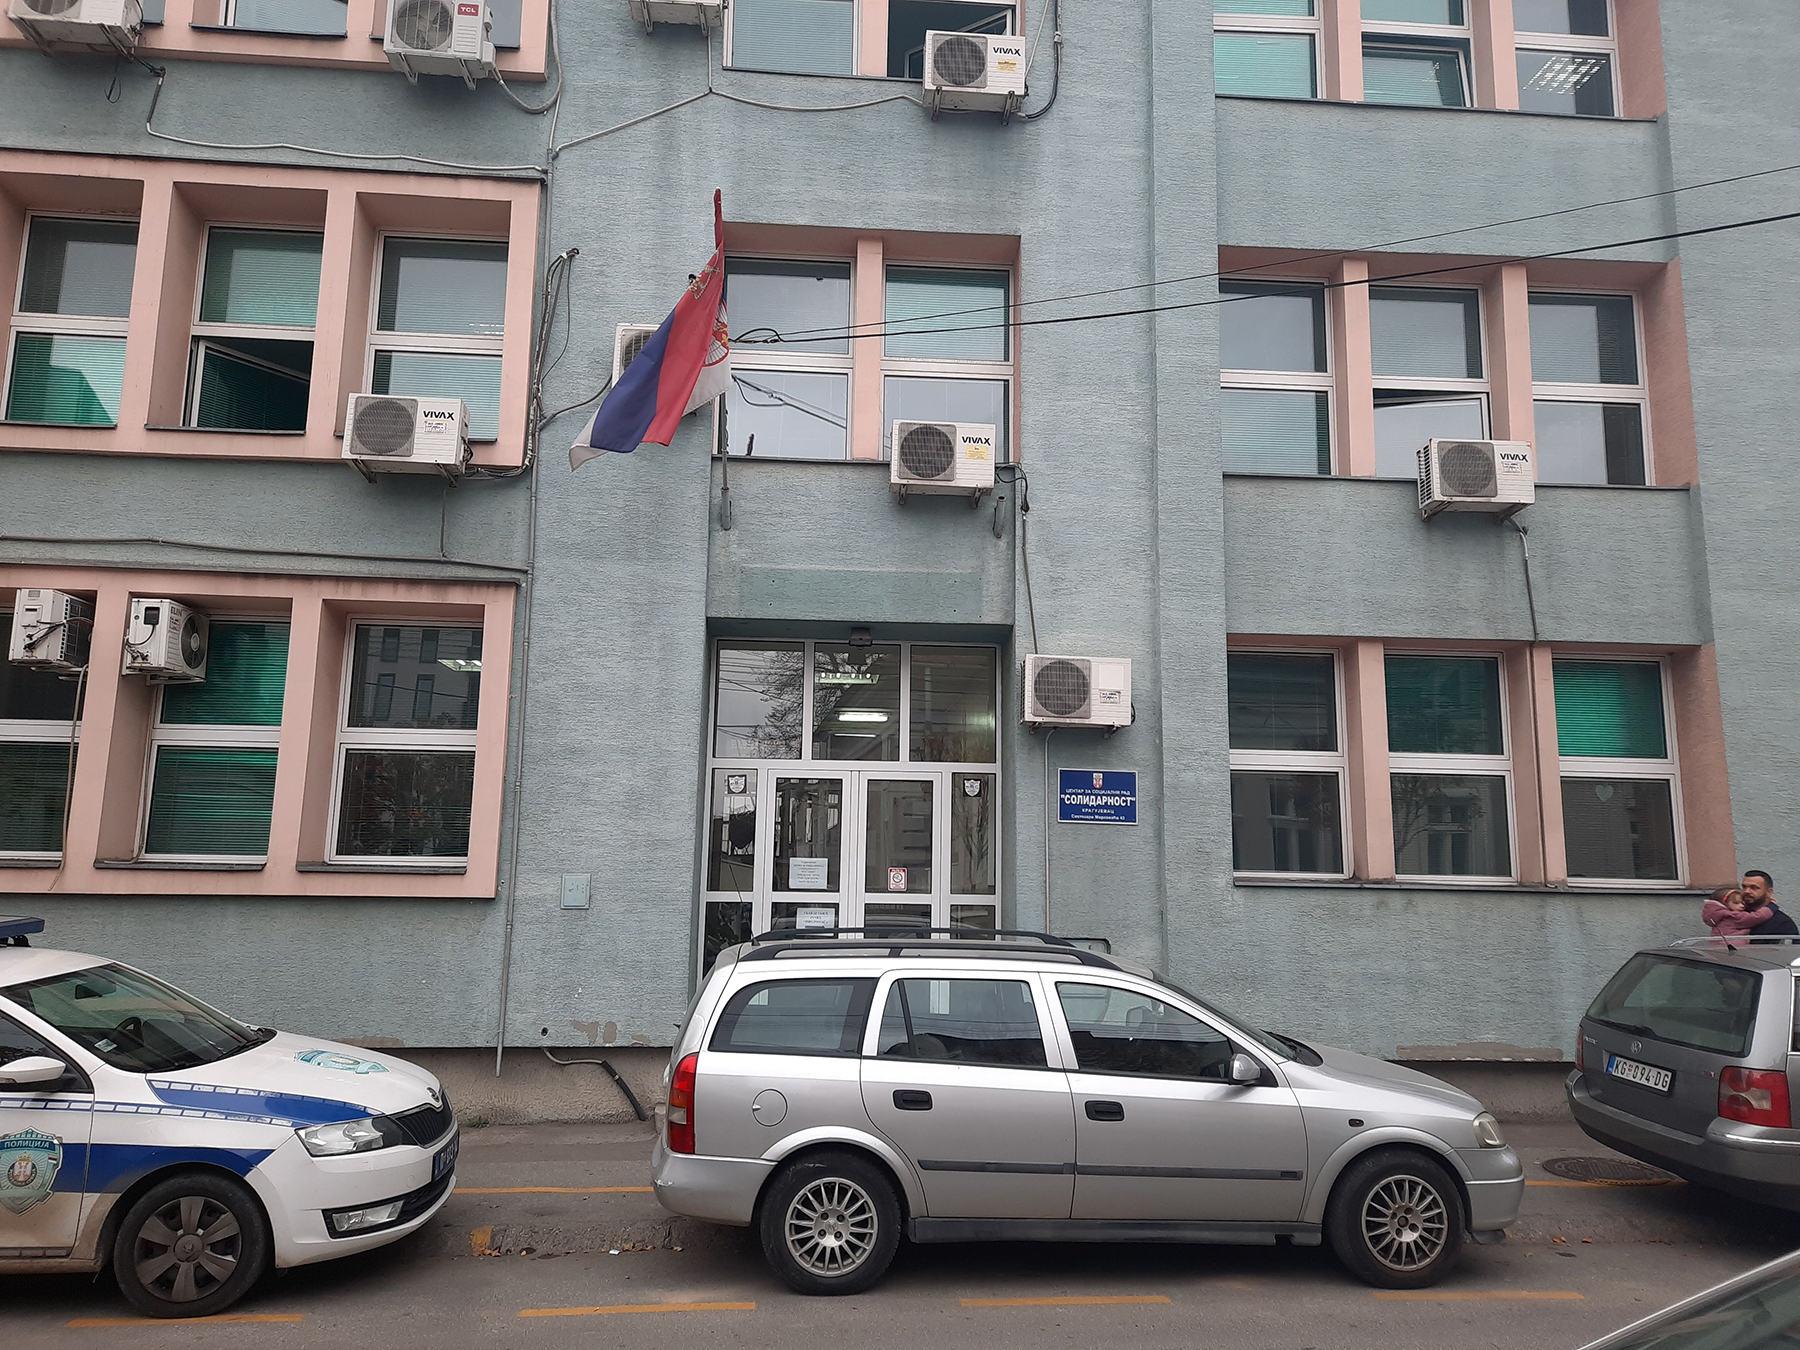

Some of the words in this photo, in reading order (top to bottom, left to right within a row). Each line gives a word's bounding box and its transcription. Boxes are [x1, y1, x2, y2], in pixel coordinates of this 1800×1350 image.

[992, 46, 1021, 56] VIVAX
[423, 410, 455, 421] VIVAX
[961, 436, 991, 446] VIVAX
[1499, 453, 1528, 462] VIVAX
[1060, 795, 1135, 807] "СОЛИДАРНОСТ"
[1614, 1059, 1626, 1075] KG
[4, 1140, 50, 1148] ПОЛИЦИЈА
